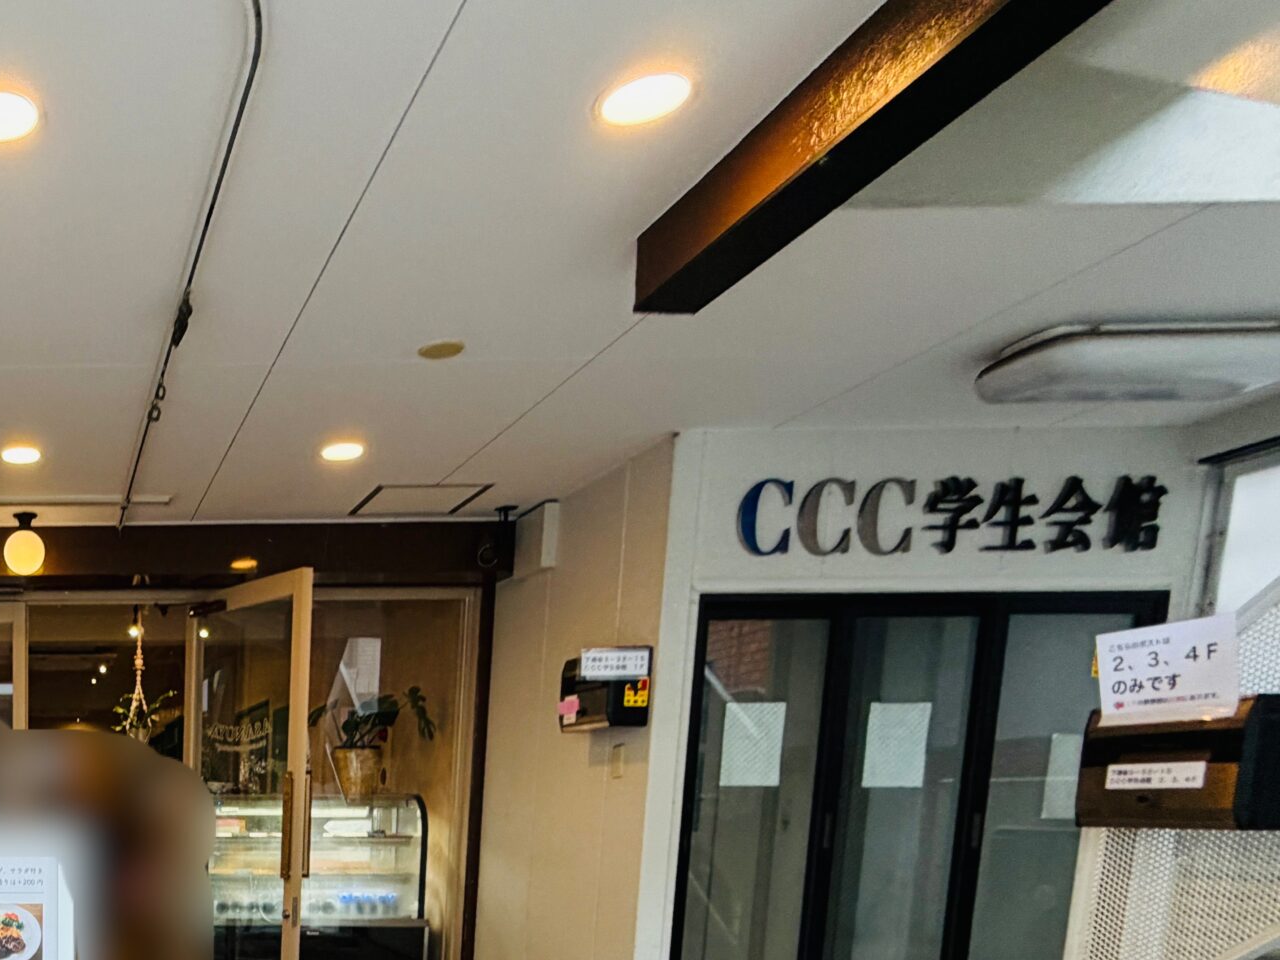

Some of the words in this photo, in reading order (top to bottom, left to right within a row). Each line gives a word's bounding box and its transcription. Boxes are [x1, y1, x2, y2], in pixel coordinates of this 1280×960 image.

[736, 474, 1169, 557] CCC学生会館
[1112, 673, 1181, 695] のみです
